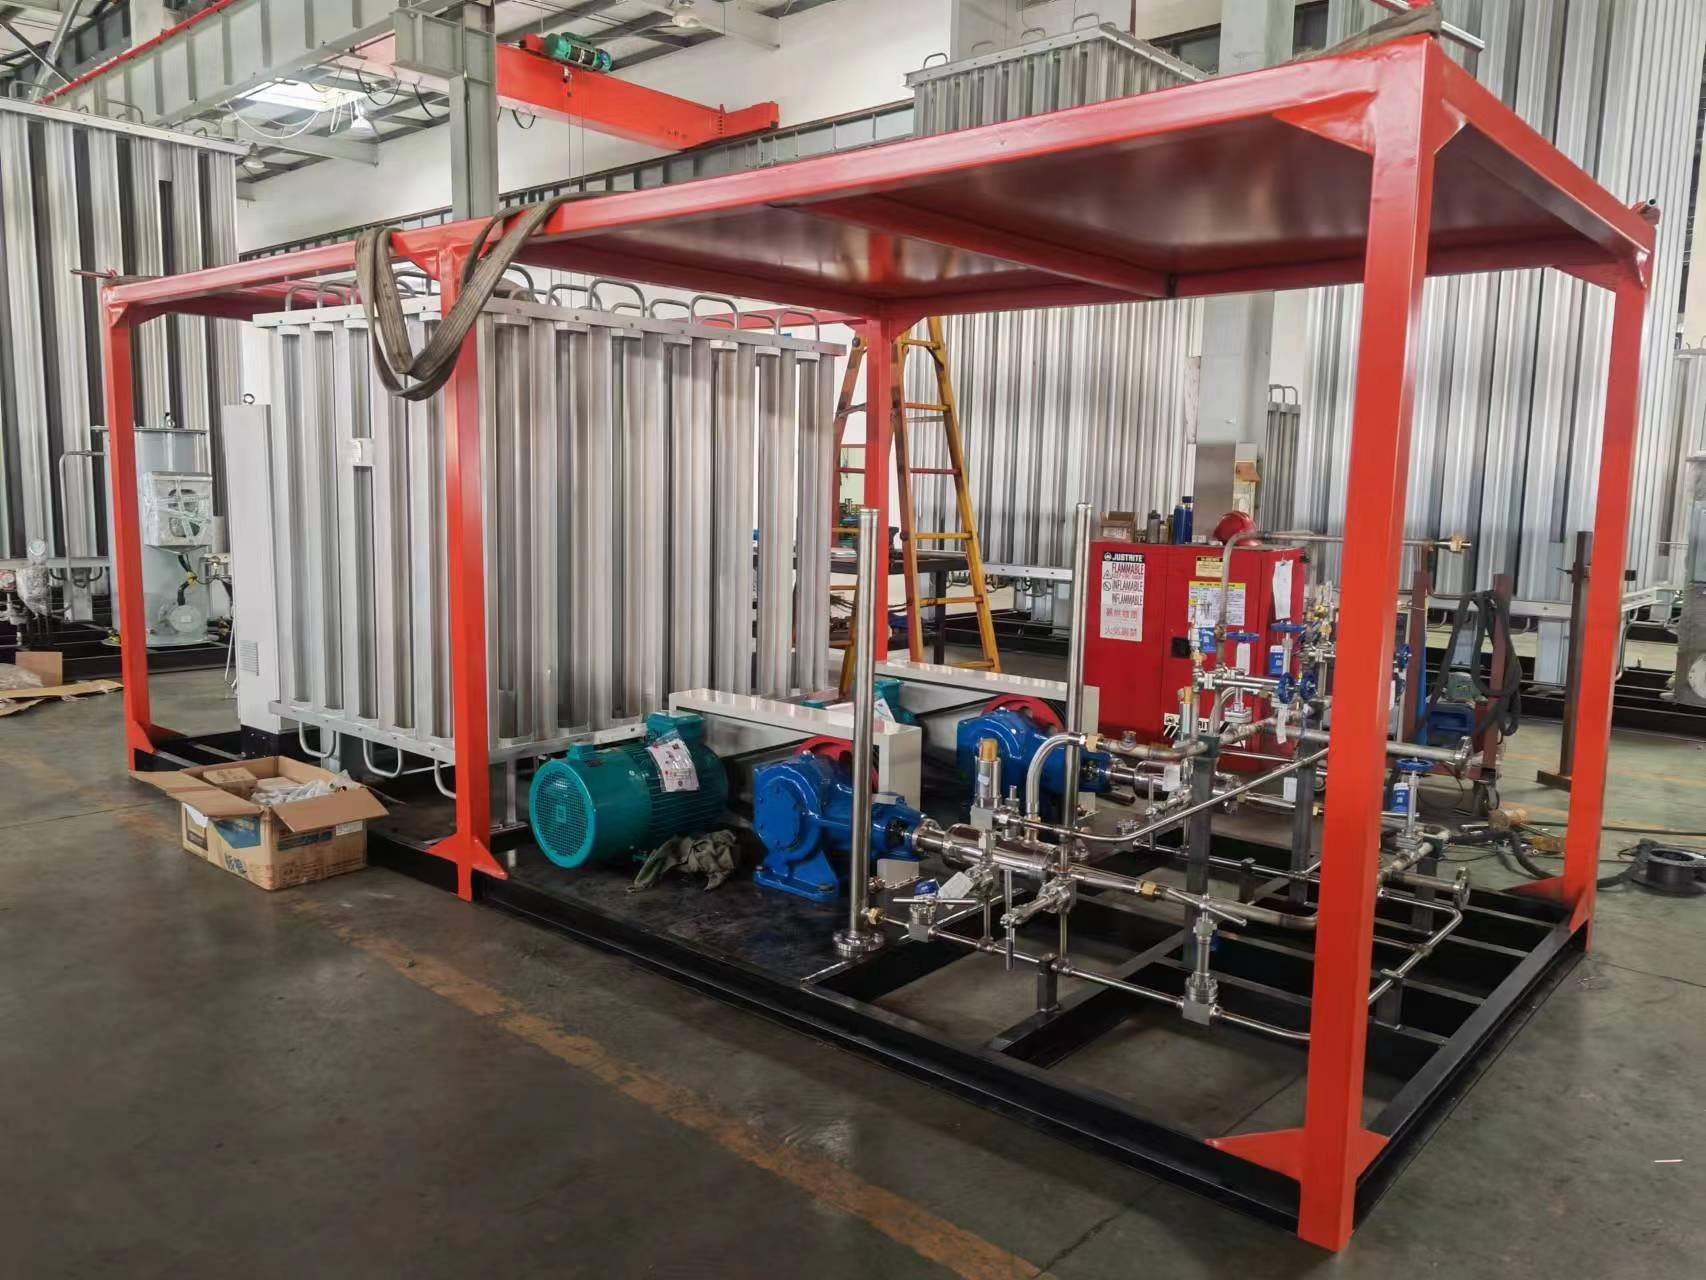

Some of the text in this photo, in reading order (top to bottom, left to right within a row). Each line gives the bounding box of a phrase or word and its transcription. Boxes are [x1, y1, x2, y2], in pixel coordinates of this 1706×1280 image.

[1112, 553, 1143, 563] JUSTRITE
[1112, 562, 1143, 575] FLAMMABLE
[1112, 593, 1143, 605] INFLAMMABLE
